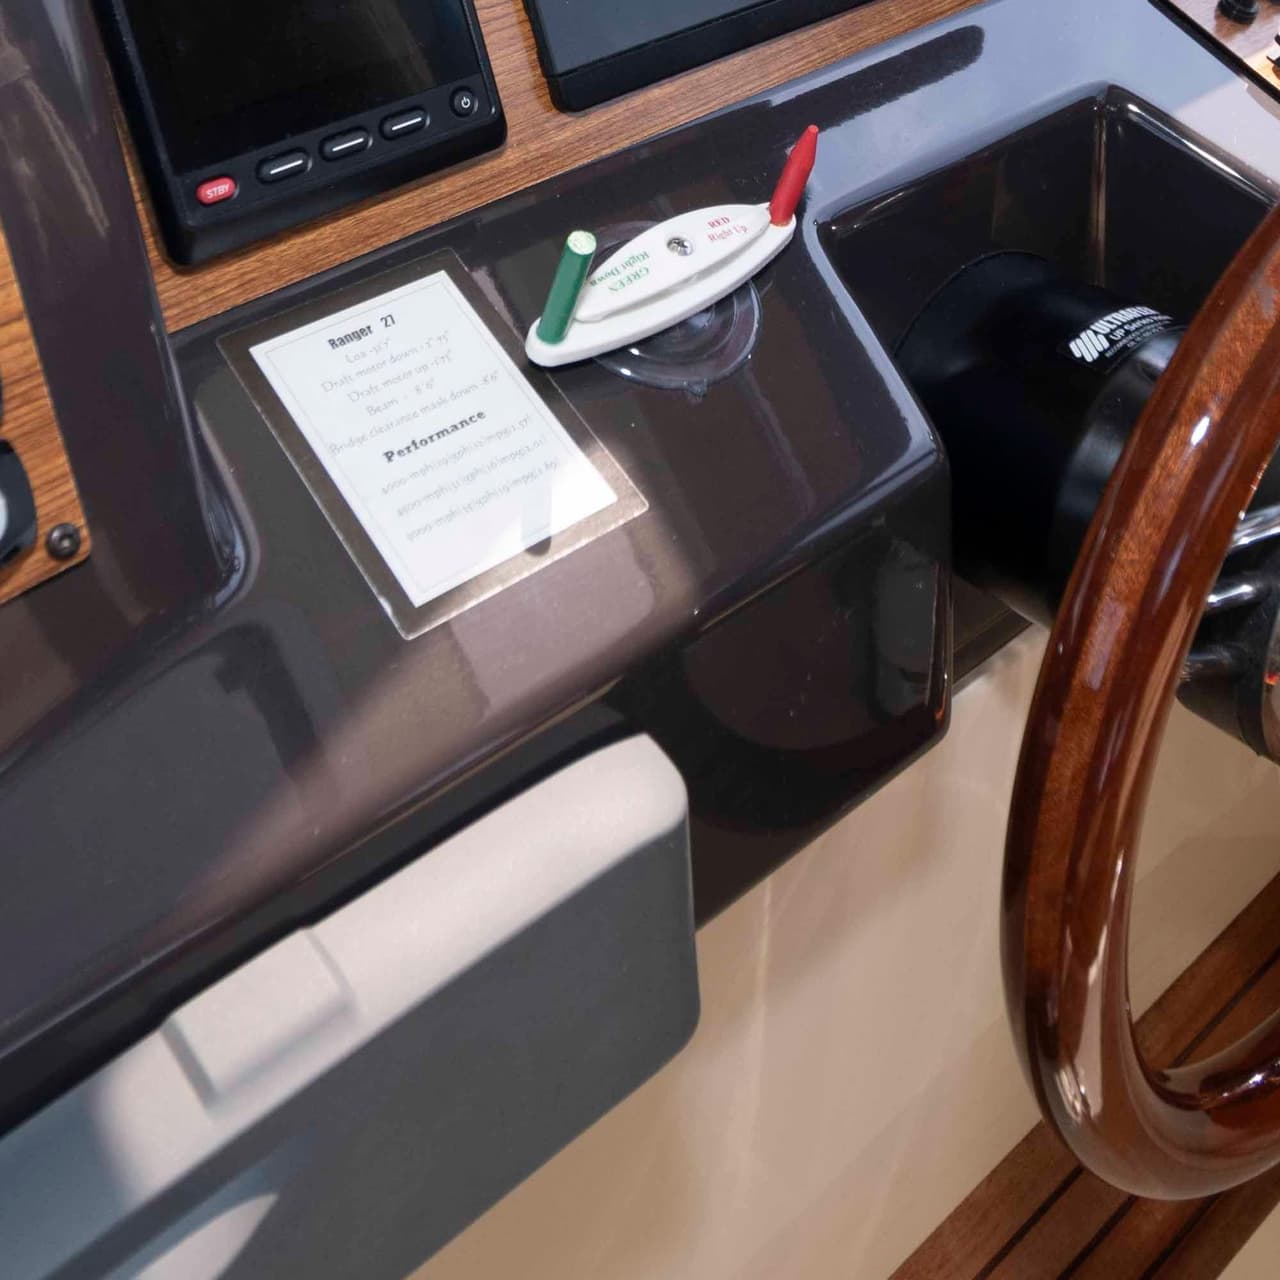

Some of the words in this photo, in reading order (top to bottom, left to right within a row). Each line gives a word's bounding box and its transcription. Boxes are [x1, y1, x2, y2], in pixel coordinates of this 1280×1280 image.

[207, 183, 230, 199] STBY
[708, 217, 730, 228] RED
[708, 227, 734, 242] Right
[609, 267, 649, 292] GREEN
[328, 325, 373, 350] Ranger
[380, 314, 396, 329] 27
[383, 410, 487, 463] Performance
